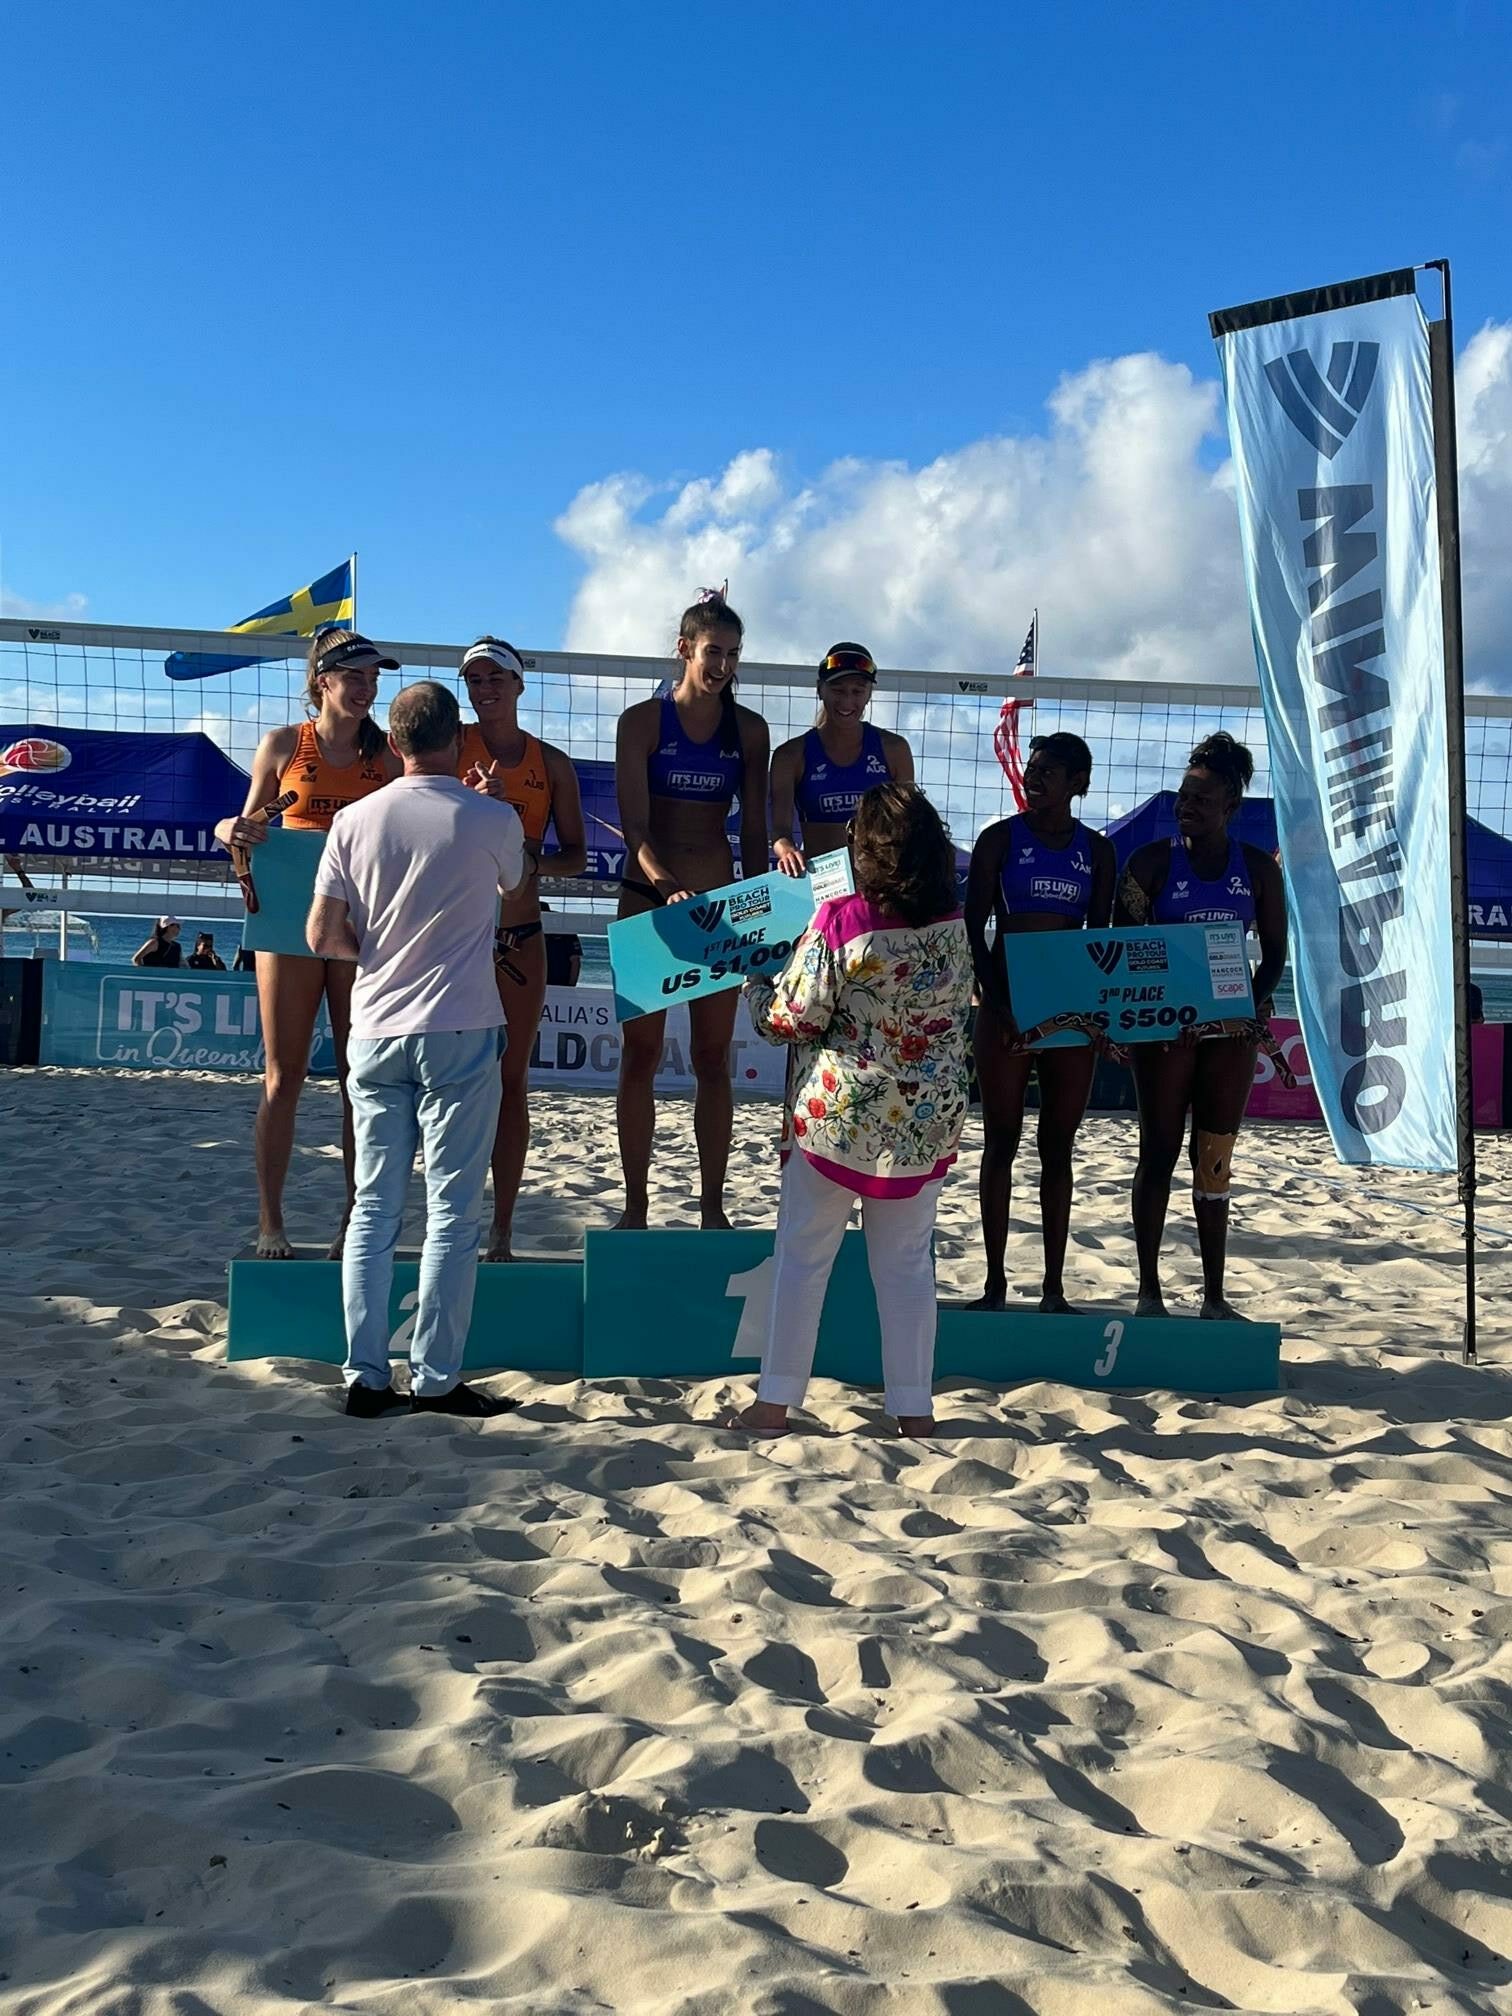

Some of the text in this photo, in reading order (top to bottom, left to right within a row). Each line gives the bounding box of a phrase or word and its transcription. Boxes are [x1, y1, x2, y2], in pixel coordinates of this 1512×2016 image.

[866, 765, 887, 774] AUS
[524, 779, 545, 791] AUS
[692, 775, 721, 787] LIVE!
[0, 783, 142, 809] olleyball
[844, 794, 865, 806] LIV
[1071, 860, 1092, 874] VAN
[1052, 881, 1077, 896] LIVE!
[1230, 876, 1243, 887] 2
[729, 887, 769, 906] BEACH
[1226, 886, 1251, 897] VAN
[730, 895, 770, 912] PRO TOUR
[723, 927, 767, 952] PLACE
[1126, 941, 1167, 951] BEACH
[1211, 966, 1243, 974] HANCOCK
[661, 968, 701, 995] US
[1217, 983, 1245, 995] scape
[1098, 985, 1166, 1004] 3RD PLACE
[118, 989, 203, 1035] IT'S
[540, 1004, 608, 1026] ALIA'S
[1119, 1004, 1198, 1031] $500
[117, 1044, 141, 1062] in
[725, 1256, 776, 1358] 1
[388, 1290, 420, 1352] 2
[1094, 1320, 1124, 1376] 3
